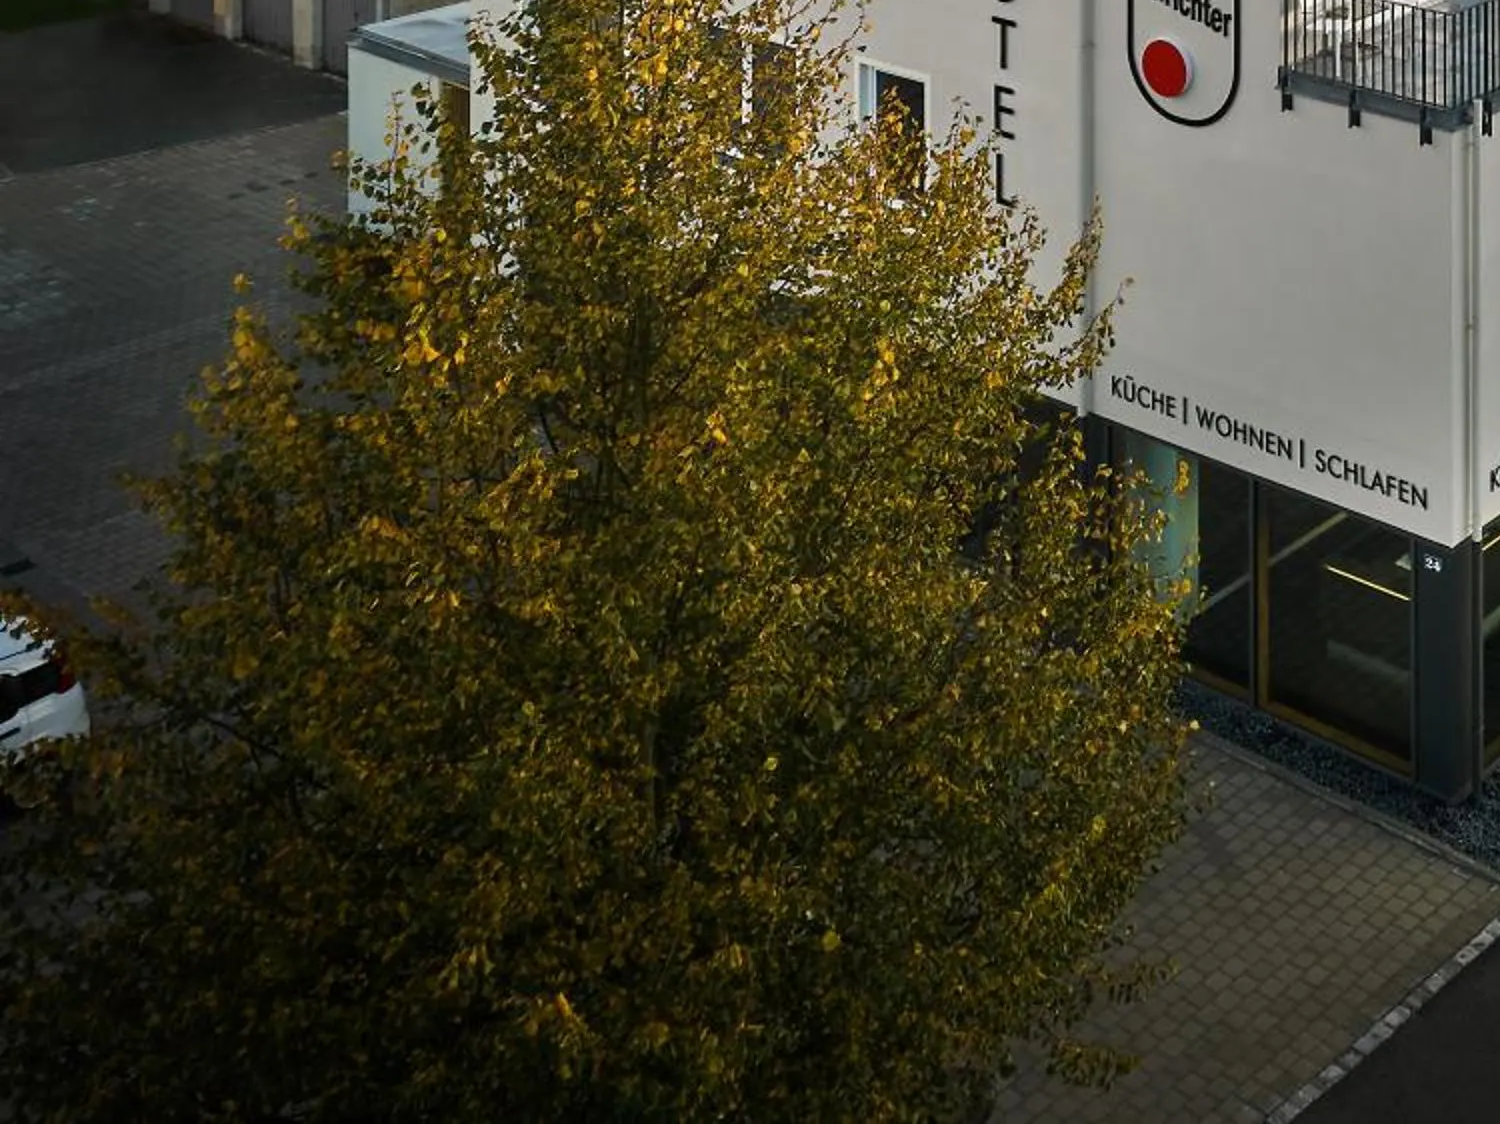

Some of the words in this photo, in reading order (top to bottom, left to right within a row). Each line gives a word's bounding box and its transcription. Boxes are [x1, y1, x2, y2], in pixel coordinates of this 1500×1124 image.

[1111, 375, 1177, 418] KÜCHE
[1195, 404, 1293, 460] WOHNEN
[1314, 448, 1428, 510] SCHLAFEN
